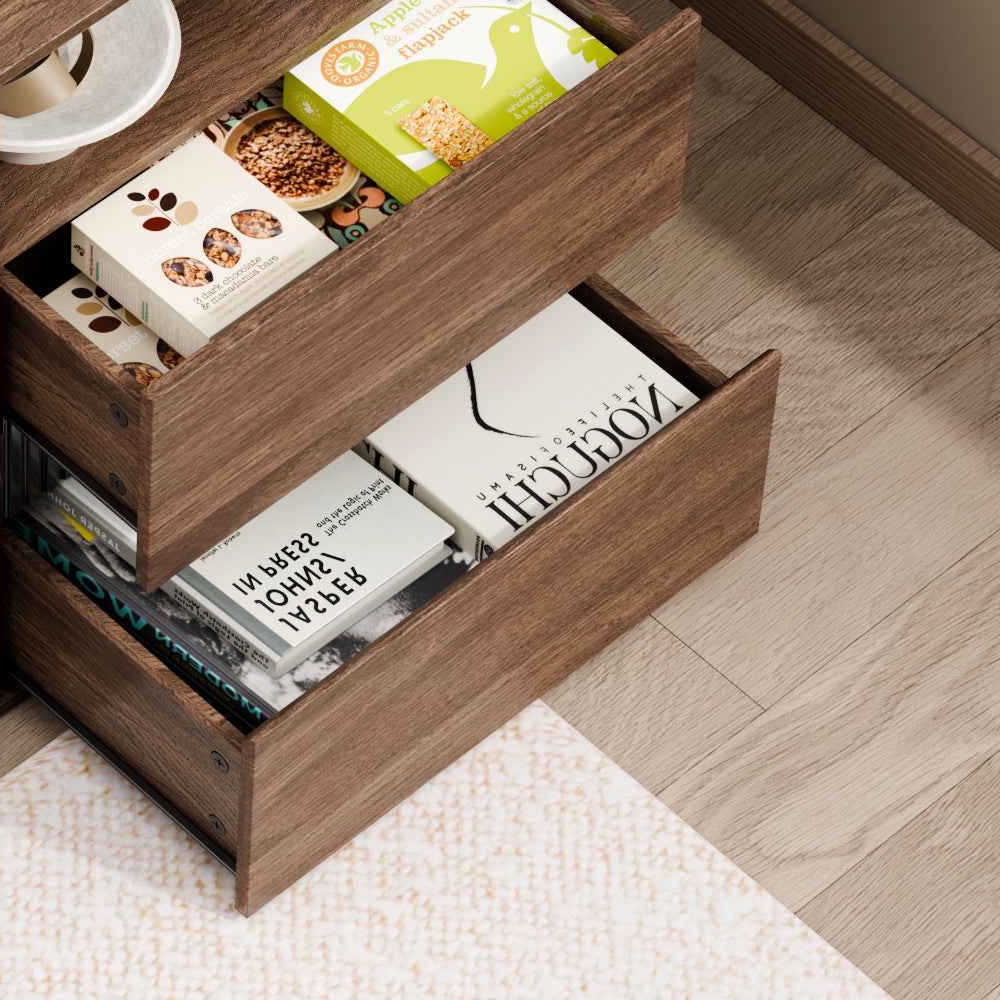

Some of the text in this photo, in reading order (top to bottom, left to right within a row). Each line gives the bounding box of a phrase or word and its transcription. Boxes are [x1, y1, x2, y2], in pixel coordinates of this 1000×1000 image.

[384, 34, 402, 46] &
[397, 9, 471, 60] flapjack
[324, 52, 340, 83] DOVES
[344, 50, 377, 85] ORGANIC
[506, 85, 546, 113] wholegrain
[511, 87, 525, 98] low
[527, 91, 554, 111] source
[144, 190, 250, 265] dorset cereals
[194, 255, 262, 305] 3 dark chocolate
[200, 254, 279, 311] & macadamia bars
[110, 329, 148, 360] rset
